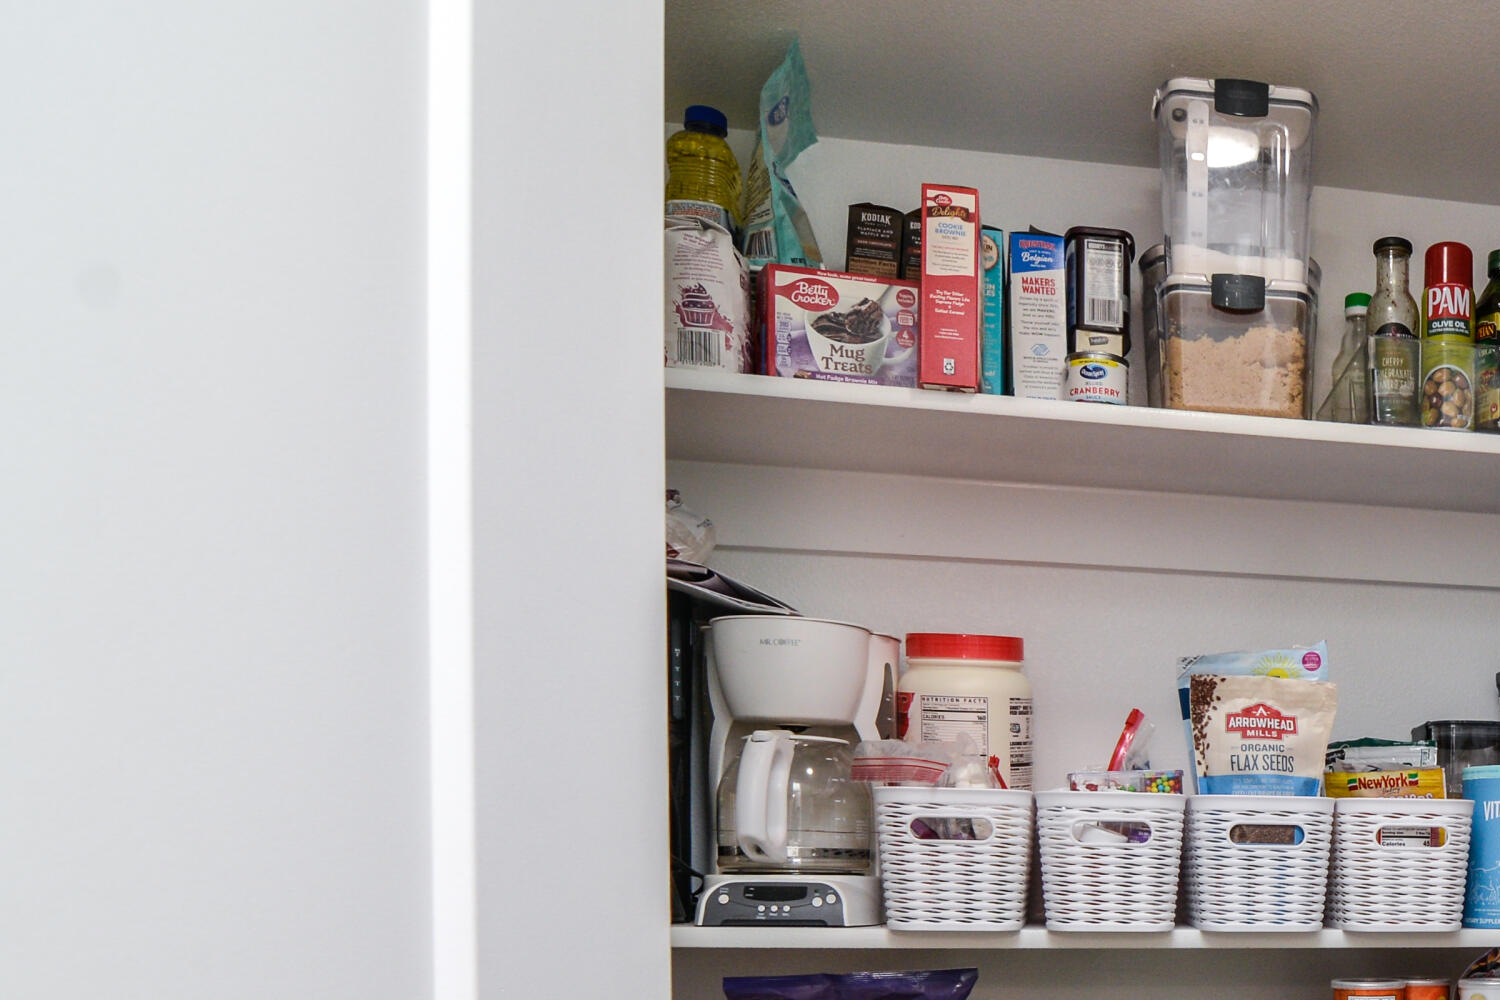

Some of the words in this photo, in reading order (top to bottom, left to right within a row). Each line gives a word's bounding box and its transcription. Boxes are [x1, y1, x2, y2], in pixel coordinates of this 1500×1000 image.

[861, 212, 892, 226] KODIAK
[938, 222, 963, 230] COOKIE
[934, 228, 966, 237] BROWNIE
[1021, 276, 1056, 287] MAKERS
[1022, 286, 1056, 296] WANTED
[1427, 286, 1470, 317] PAM
[1432, 320, 1454, 329] OLIVE
[1454, 321, 1466, 329] OIL
[829, 344, 865, 361] Mug
[821, 356, 873, 374] Treats
[824, 374, 844, 382] Fudge
[844, 376, 867, 384] Brownie
[1069, 385, 1120, 398] CRANBERRY
[1228, 716, 1294, 731] ARROWHEAD
[1246, 730, 1278, 738] MILLS
[1240, 743, 1285, 753] ORGANIC
[1230, 754, 1259, 772] FLAX
[1262, 754, 1295, 773] SEEDS
